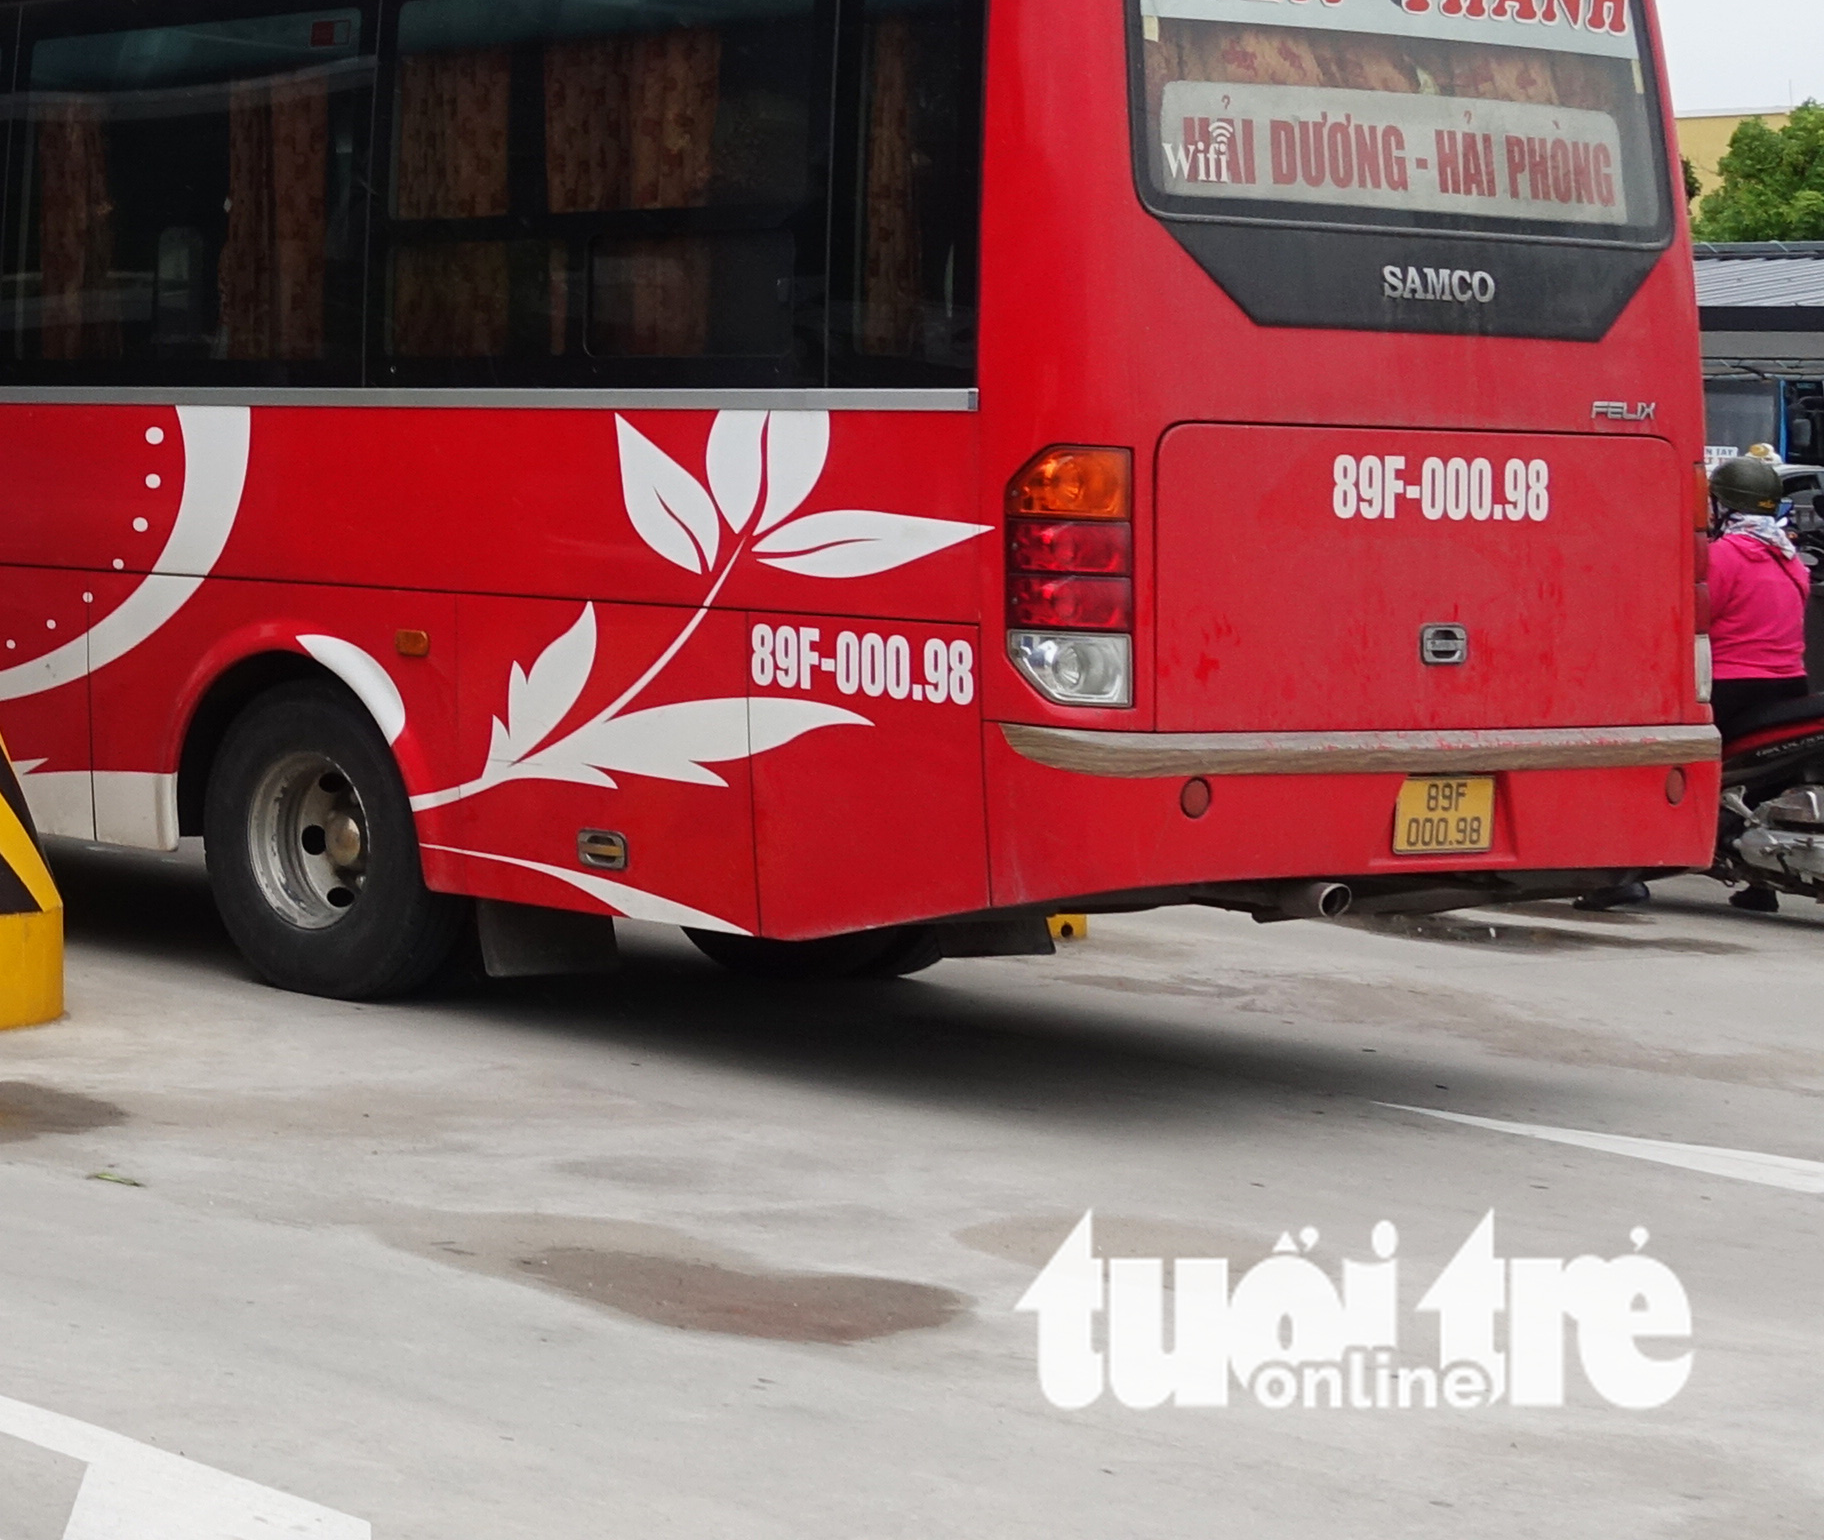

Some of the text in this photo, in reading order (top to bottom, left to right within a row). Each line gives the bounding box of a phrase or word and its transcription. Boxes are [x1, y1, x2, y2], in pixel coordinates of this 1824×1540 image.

[1162, 140, 1229, 184] Wifi
[1182, 95, 1254, 185] HẢI
[1269, 112, 1409, 192] DƯƠNG
[1436, 112, 1498, 198] HẢI
[1504, 121, 1616, 207] PHÒNG
[1383, 265, 1495, 303] SAMCO
[1591, 401, 1656, 421] FELIX
[1332, 453, 1549, 524] 89F-000.98
[750, 623, 974, 707] 89F-000.98
[1426, 782, 1467, 812] 89F
[1406, 816, 1481, 847] 000.98
